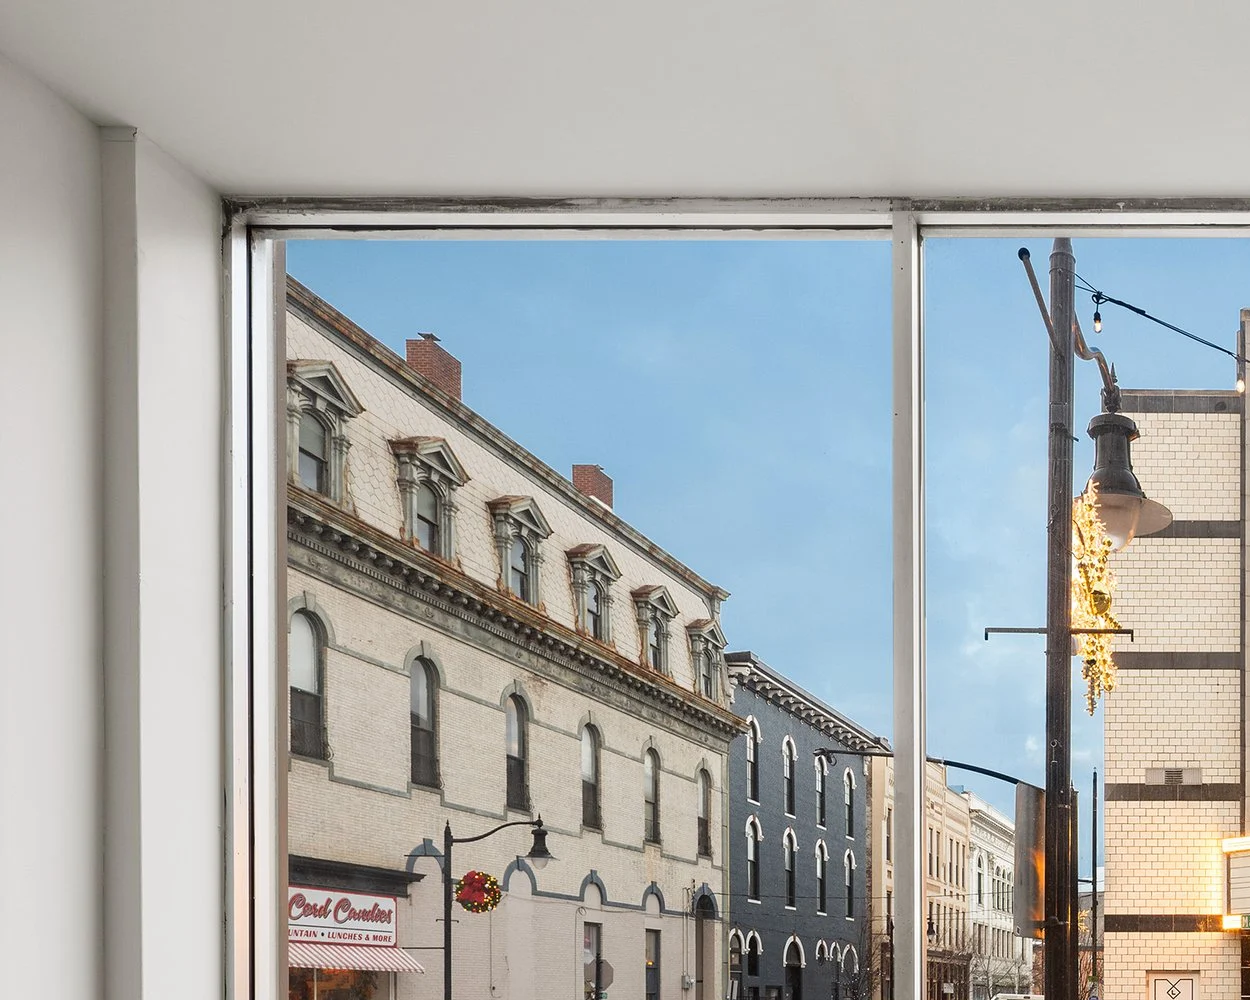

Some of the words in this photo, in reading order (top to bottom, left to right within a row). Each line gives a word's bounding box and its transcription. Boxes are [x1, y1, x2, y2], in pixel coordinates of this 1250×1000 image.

[288, 893, 332, 920] Cord
[334, 897, 393, 924] Candies
[327, 931, 363, 941] LUNCHES
[372, 934, 392, 943] MORE
